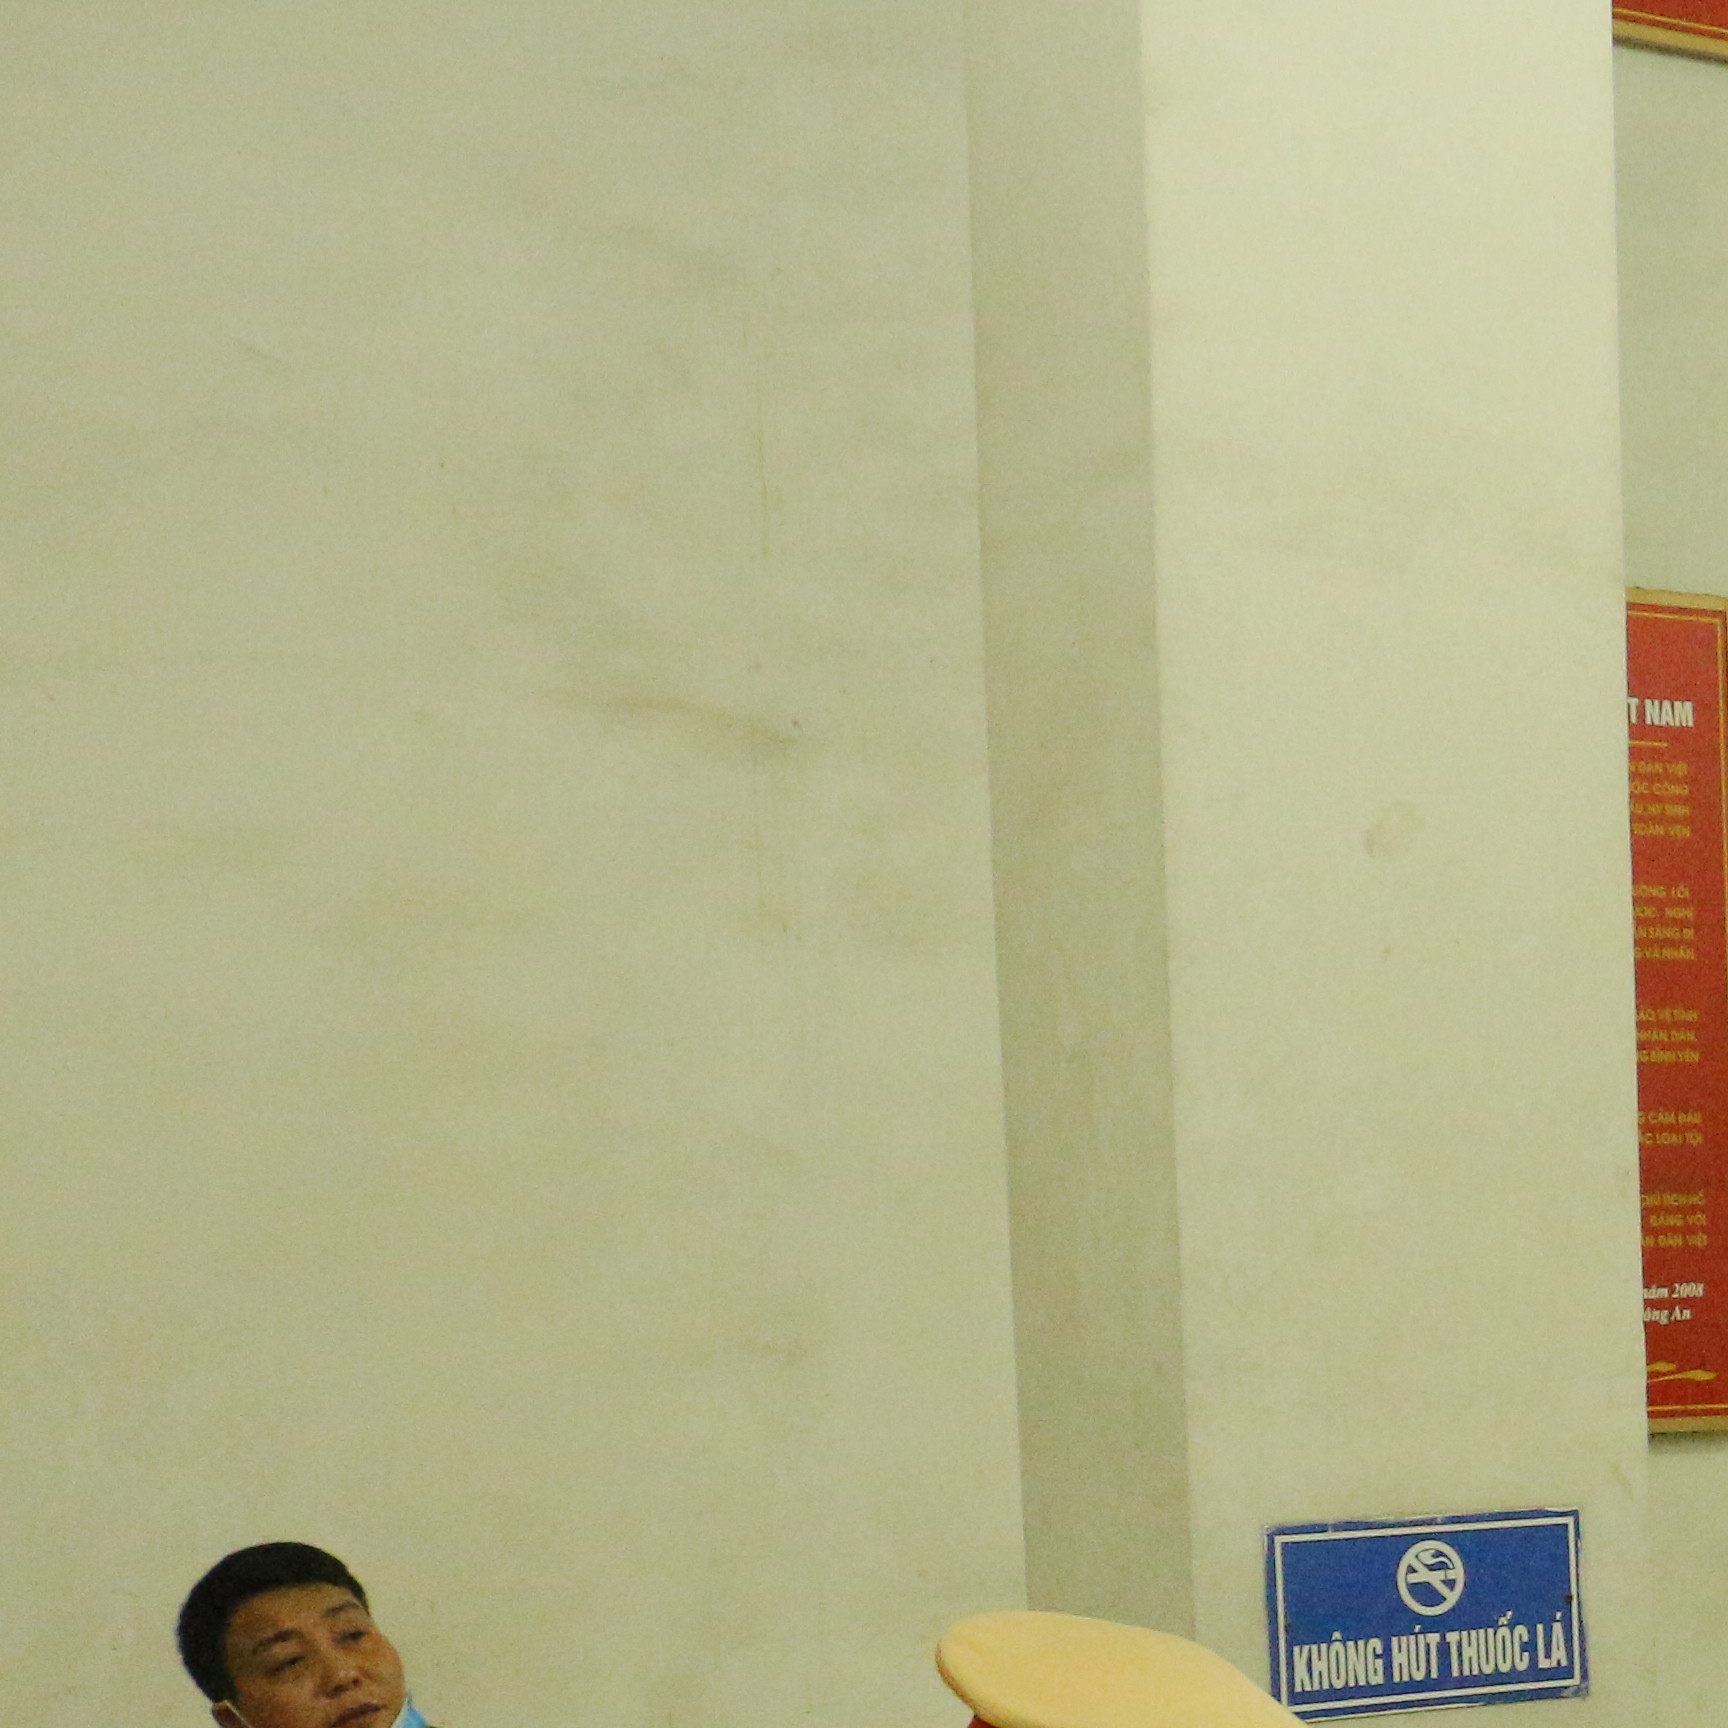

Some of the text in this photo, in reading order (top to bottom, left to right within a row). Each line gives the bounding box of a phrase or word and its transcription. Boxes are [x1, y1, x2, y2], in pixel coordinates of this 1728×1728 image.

[1644, 699, 1694, 727] NAM
[1671, 1282, 1705, 1298] 2008
[1670, 1305, 1692, 1321] An
[1293, 1609, 1568, 1692] KHÔNG HÚT THUỐC LÁ
